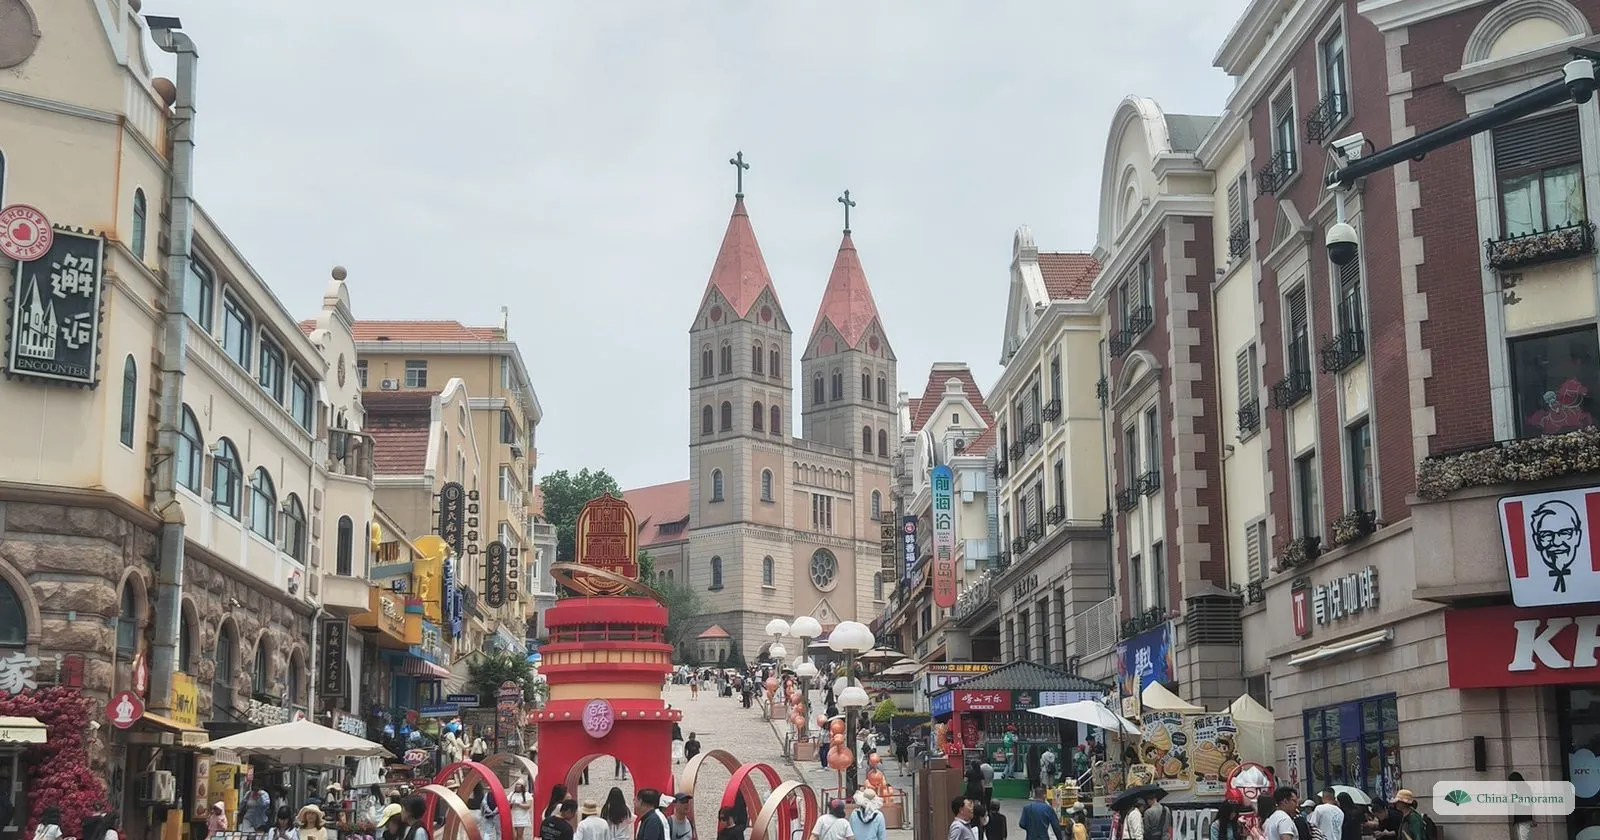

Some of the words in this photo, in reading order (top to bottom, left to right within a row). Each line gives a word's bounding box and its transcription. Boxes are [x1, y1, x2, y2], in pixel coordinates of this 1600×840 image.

[17, 359, 88, 376] ENCOUNTER
[1313, 566, 1375, 625] 肯悦咖啡
[0, 651, 40, 694] 家
[961, 693, 1002, 704] 崂山可乐
[589, 703, 609, 716] 百年
[588, 716, 609, 730] 好合
[408, 752, 423, 760] DQ
